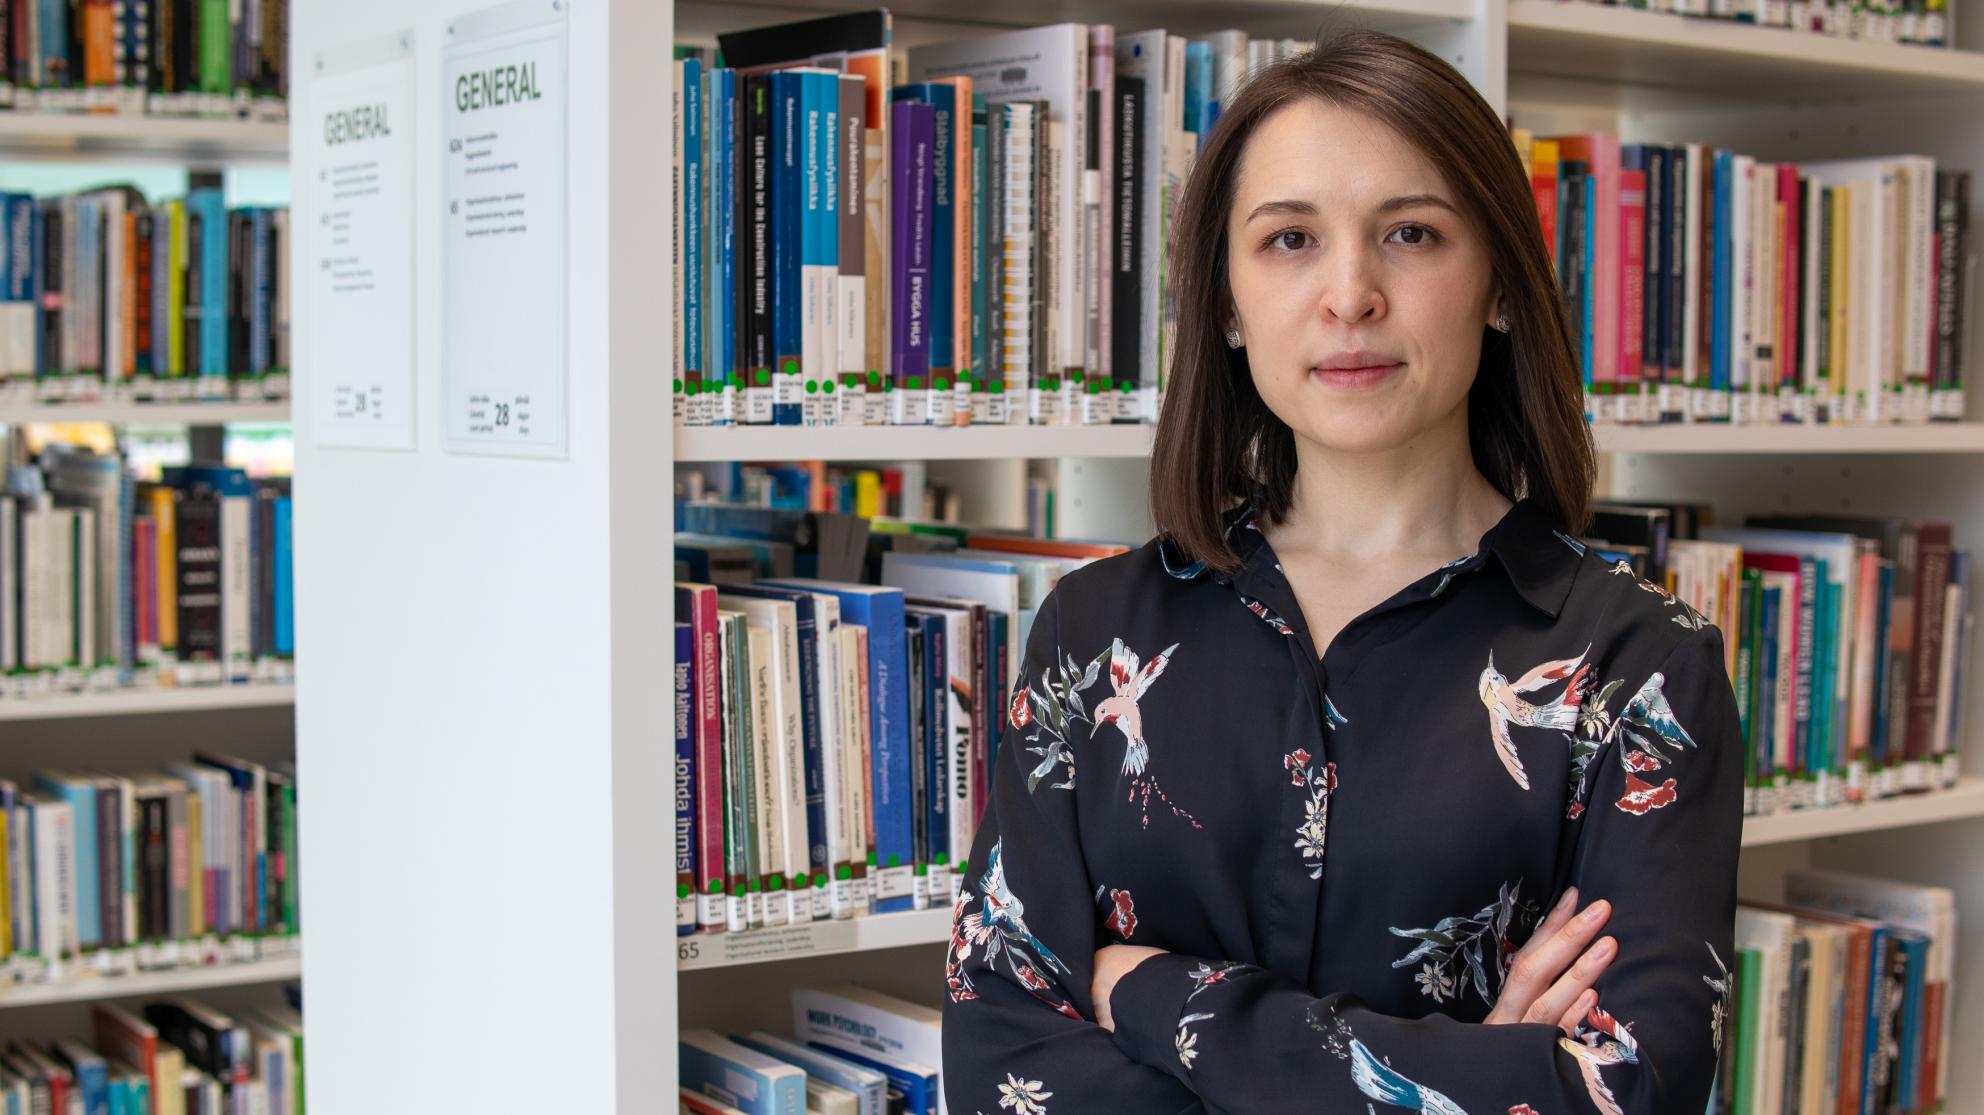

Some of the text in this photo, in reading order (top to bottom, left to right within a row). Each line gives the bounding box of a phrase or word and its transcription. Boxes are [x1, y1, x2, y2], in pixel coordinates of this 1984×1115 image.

[456, 62, 541, 114] GENERAL
[324, 101, 391, 146] GENERAL
[806, 110, 819, 210] Rakennusfysiikka
[824, 111, 837, 211] Rakennusfysiikka
[849, 117, 860, 215] Puurakentaminen
[754, 136, 765, 315] Lean Culture for the Construction Industry
[910, 276, 923, 347] BYGGA HUS
[495, 403, 510, 427] 28
[675, 660, 691, 691] Tapio
[703, 632, 717, 720] ORGANISATION
[876, 671, 889, 714] Dialogue
[675, 692, 691, 740] Aaltonen
[786, 713, 797, 738] Why
[877, 715, 890, 750] Among
[675, 753, 692, 812] Johda
[789, 739, 801, 806] Organizations?
[878, 751, 891, 805] Perspectives
[934, 759, 945, 814] Ledarskap
[955, 726, 970, 799] Pomo
[678, 942, 700, 960] 65
